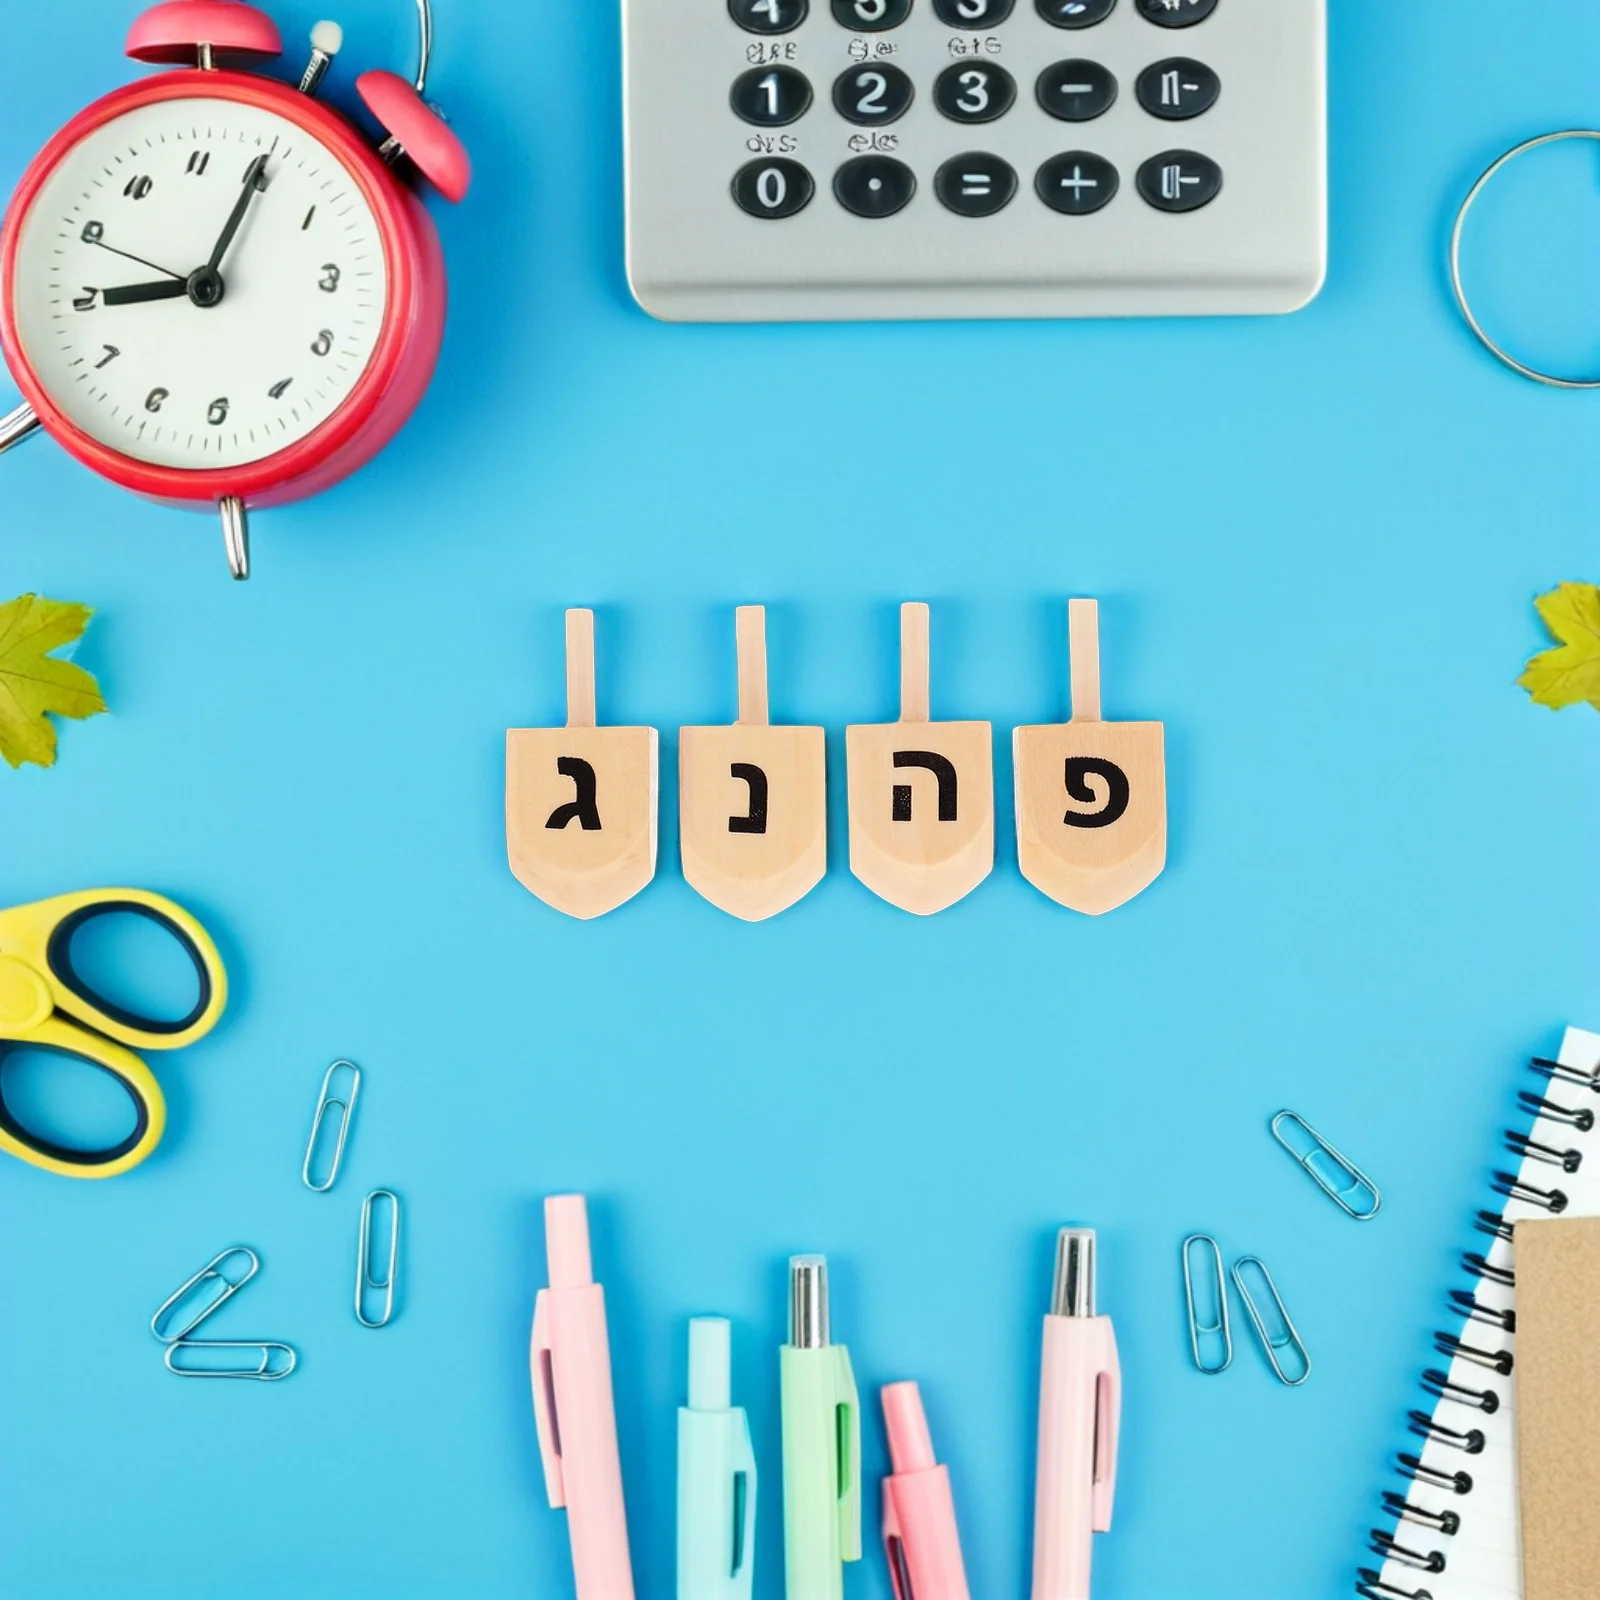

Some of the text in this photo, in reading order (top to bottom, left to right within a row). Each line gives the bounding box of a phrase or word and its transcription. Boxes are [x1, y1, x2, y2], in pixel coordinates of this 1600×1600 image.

[758, 74, 778, 115] 1
[856, 71, 888, 114] 2
[956, 70, 989, 113] 3
[756, 168, 786, 208] 0
[544, 756, 602, 831] ג
[728, 762, 768, 834] נ
[892, 750, 958, 822] ה
[1063, 756, 1130, 829] פ
